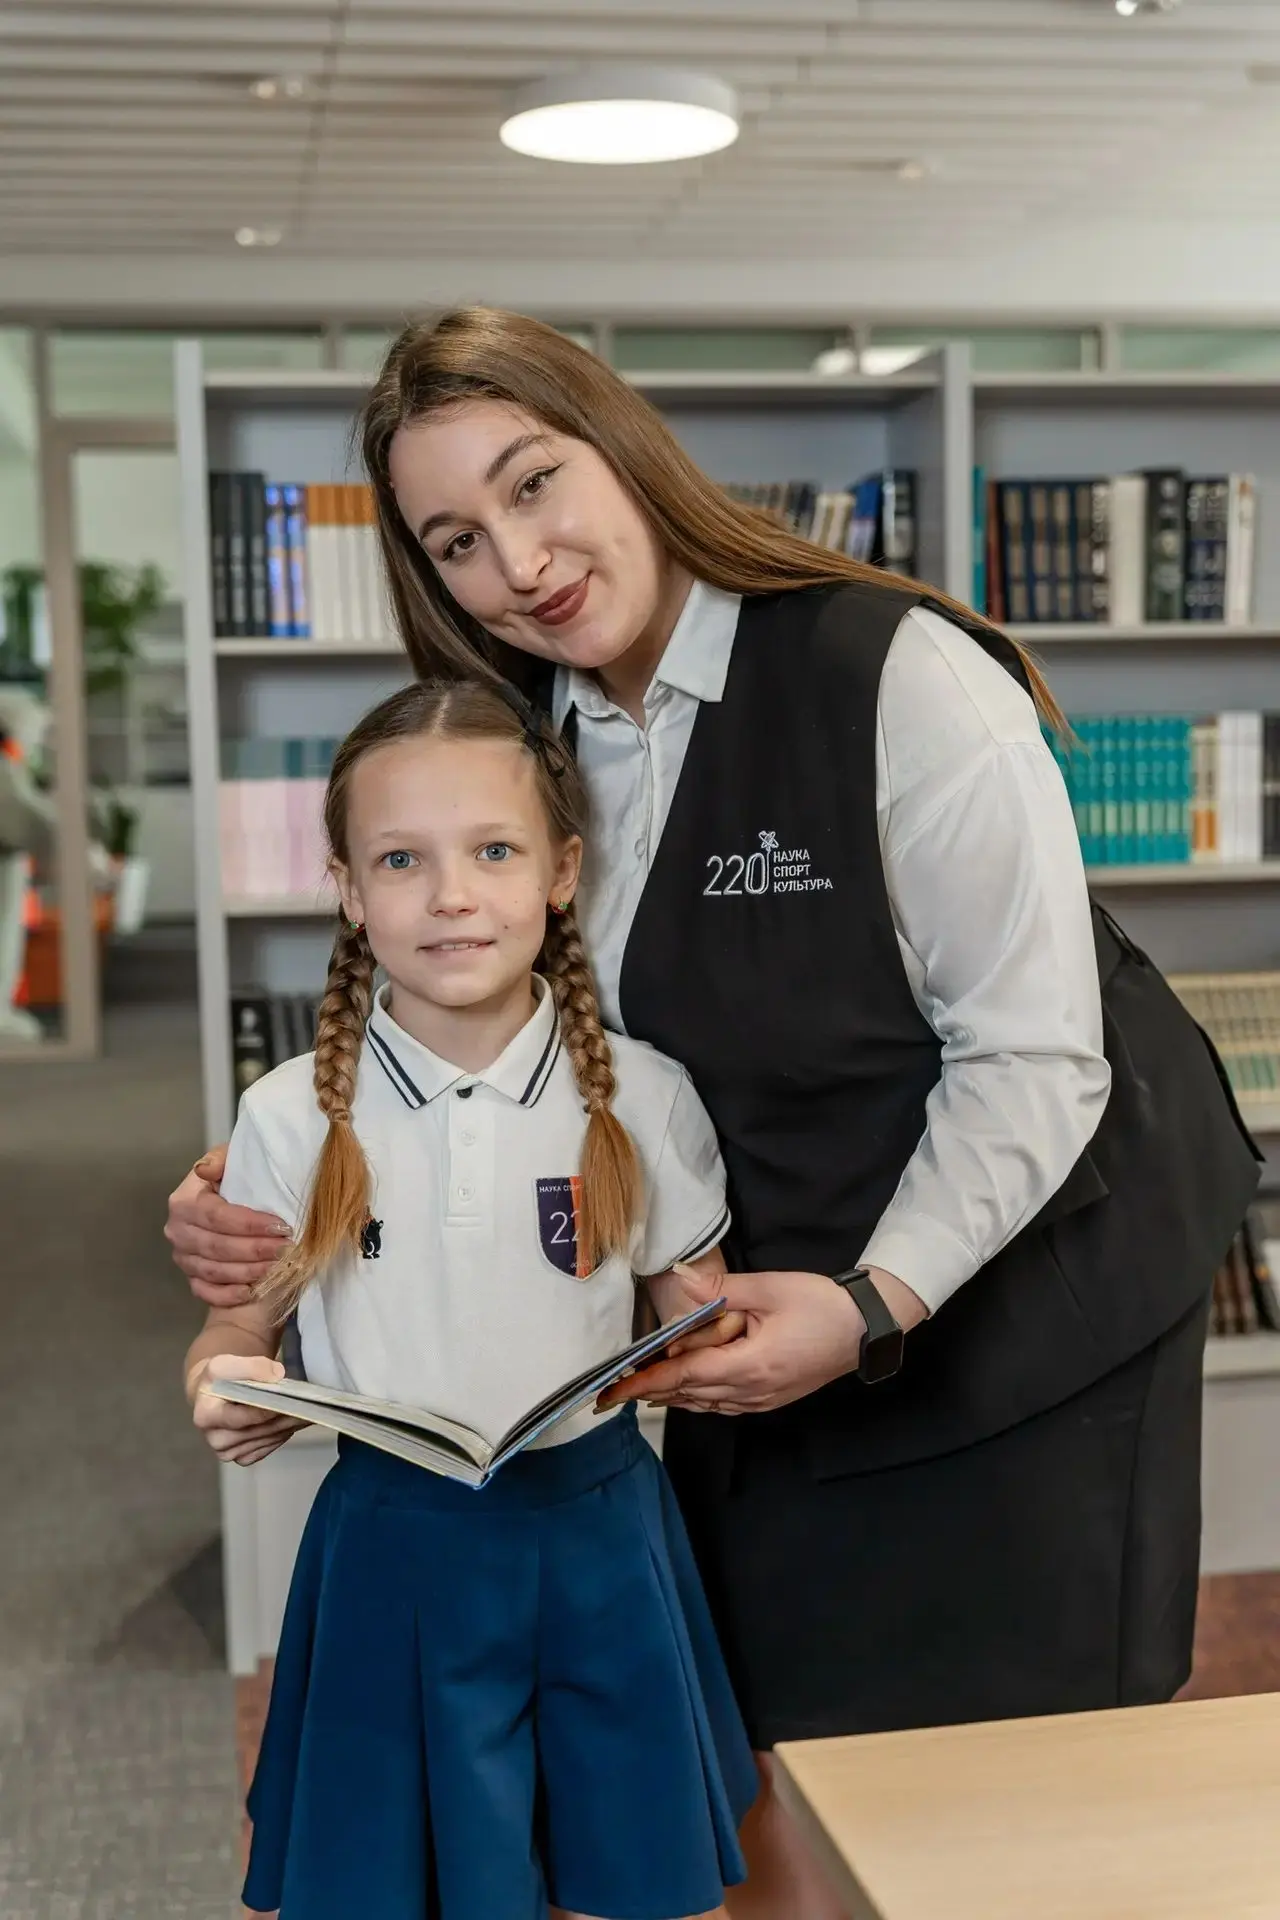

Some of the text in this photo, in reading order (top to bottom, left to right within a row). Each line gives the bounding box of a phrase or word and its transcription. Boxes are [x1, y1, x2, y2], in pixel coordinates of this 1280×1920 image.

[773, 849, 810, 863] НАУКА
[703, 852, 769, 896] 220
[773, 864, 811, 878] СПОРТ
[773, 878, 833, 893] КУЛЬТУРА
[539, 1185, 562, 1193] НАУКА
